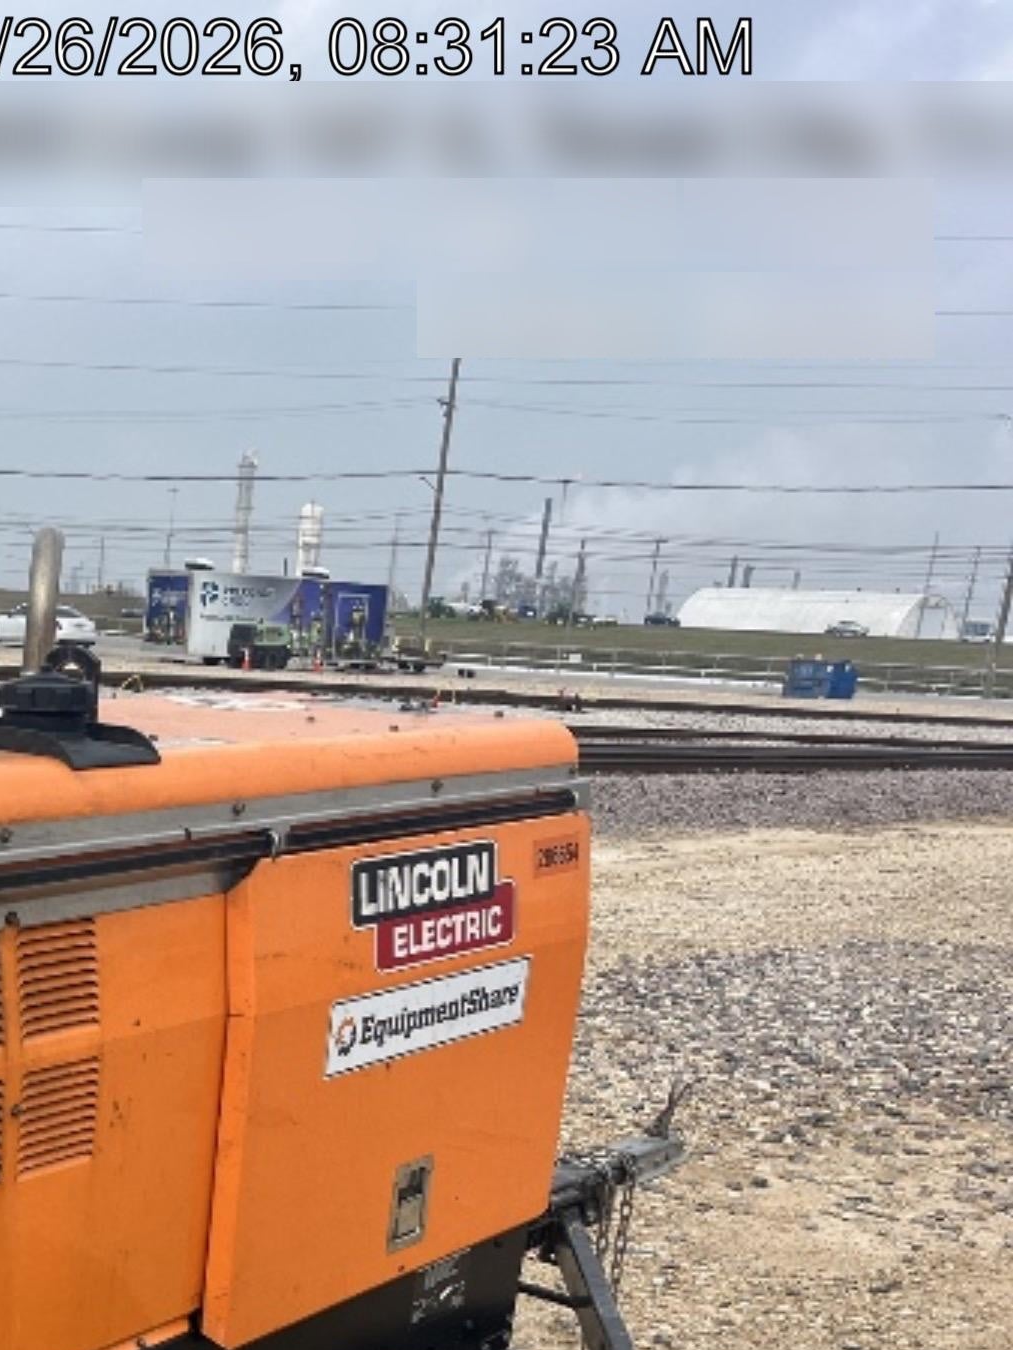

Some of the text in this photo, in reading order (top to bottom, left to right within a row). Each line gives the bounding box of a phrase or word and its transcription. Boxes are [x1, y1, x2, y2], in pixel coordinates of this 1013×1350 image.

[360, 852, 489, 915] LINCOLN
[393, 905, 502, 958] ELECTRIC
[359, 983, 520, 1047] EquipmentShare
